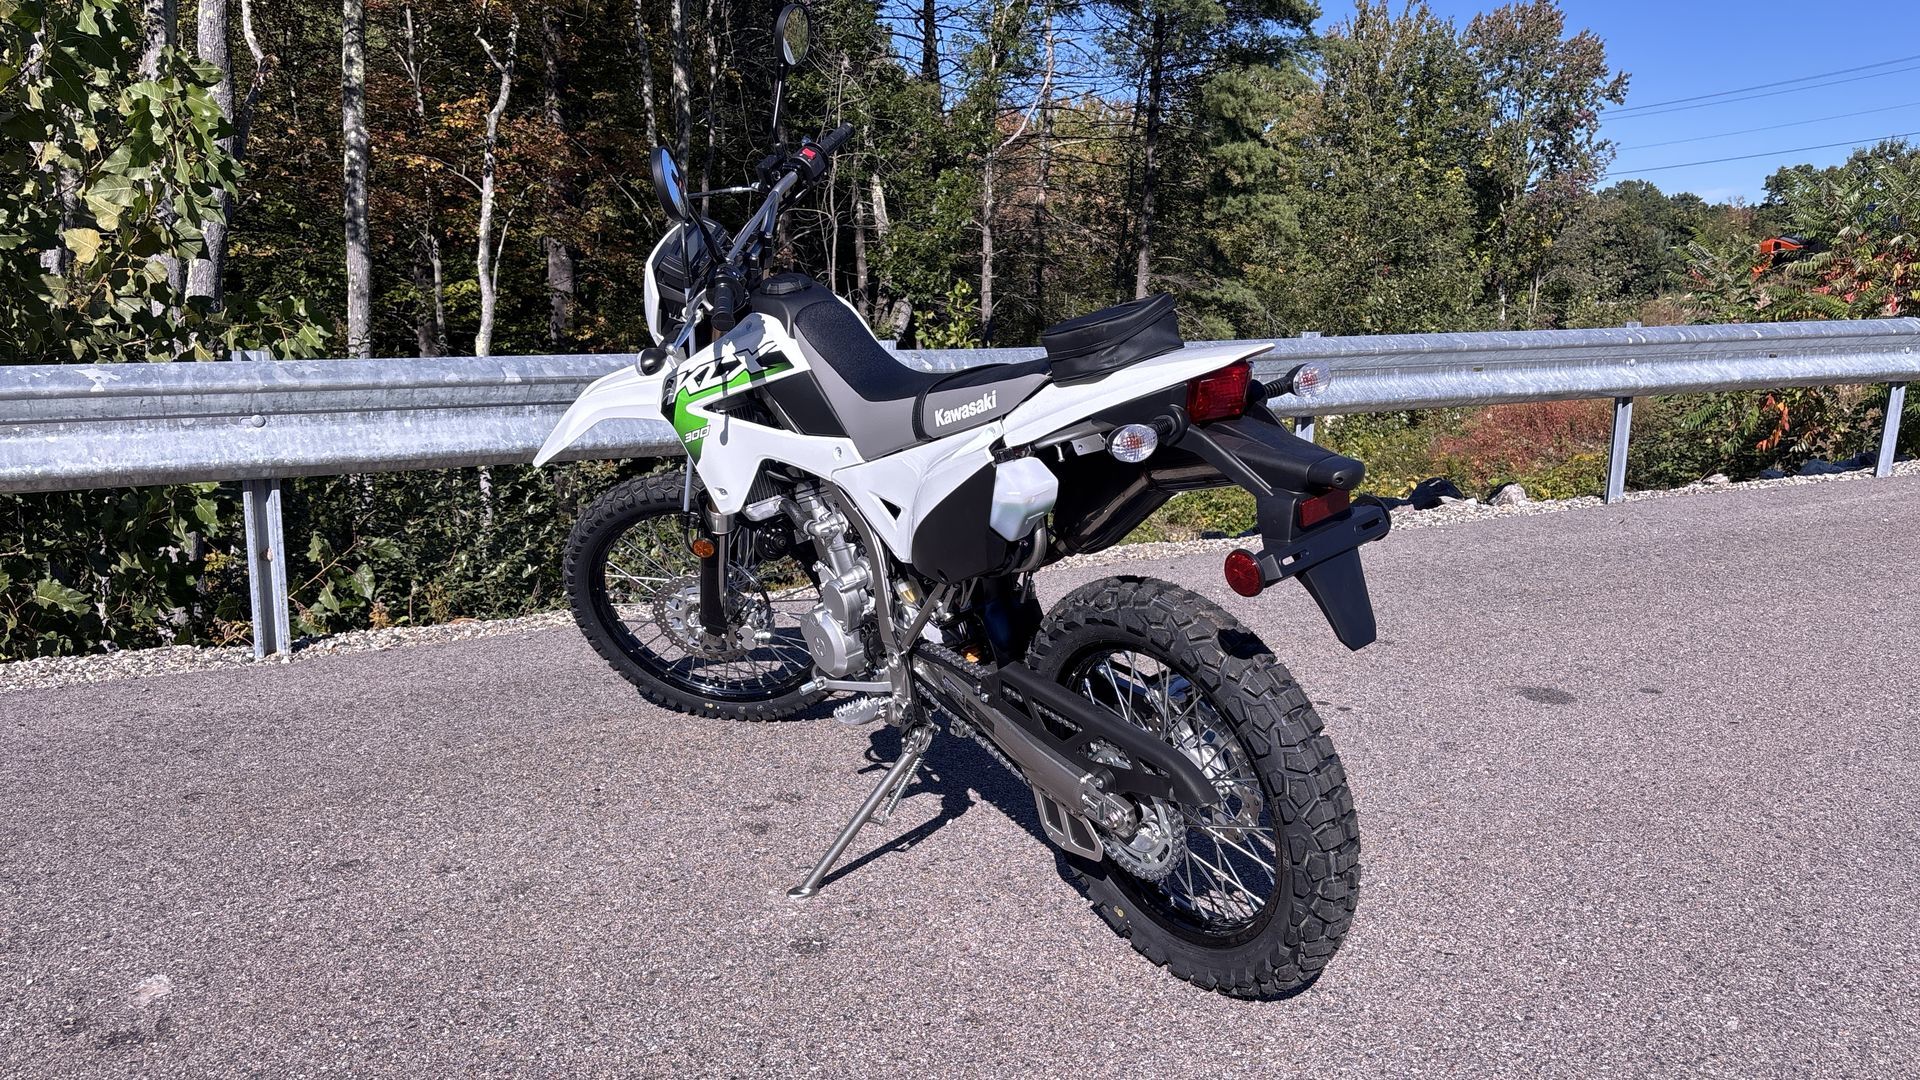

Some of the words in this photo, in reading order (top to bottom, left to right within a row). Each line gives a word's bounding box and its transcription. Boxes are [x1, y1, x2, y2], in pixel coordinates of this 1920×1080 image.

[667, 341, 777, 405] KLX
[934, 389, 997, 428] Kawasaki
[684, 425, 711, 443] 300
